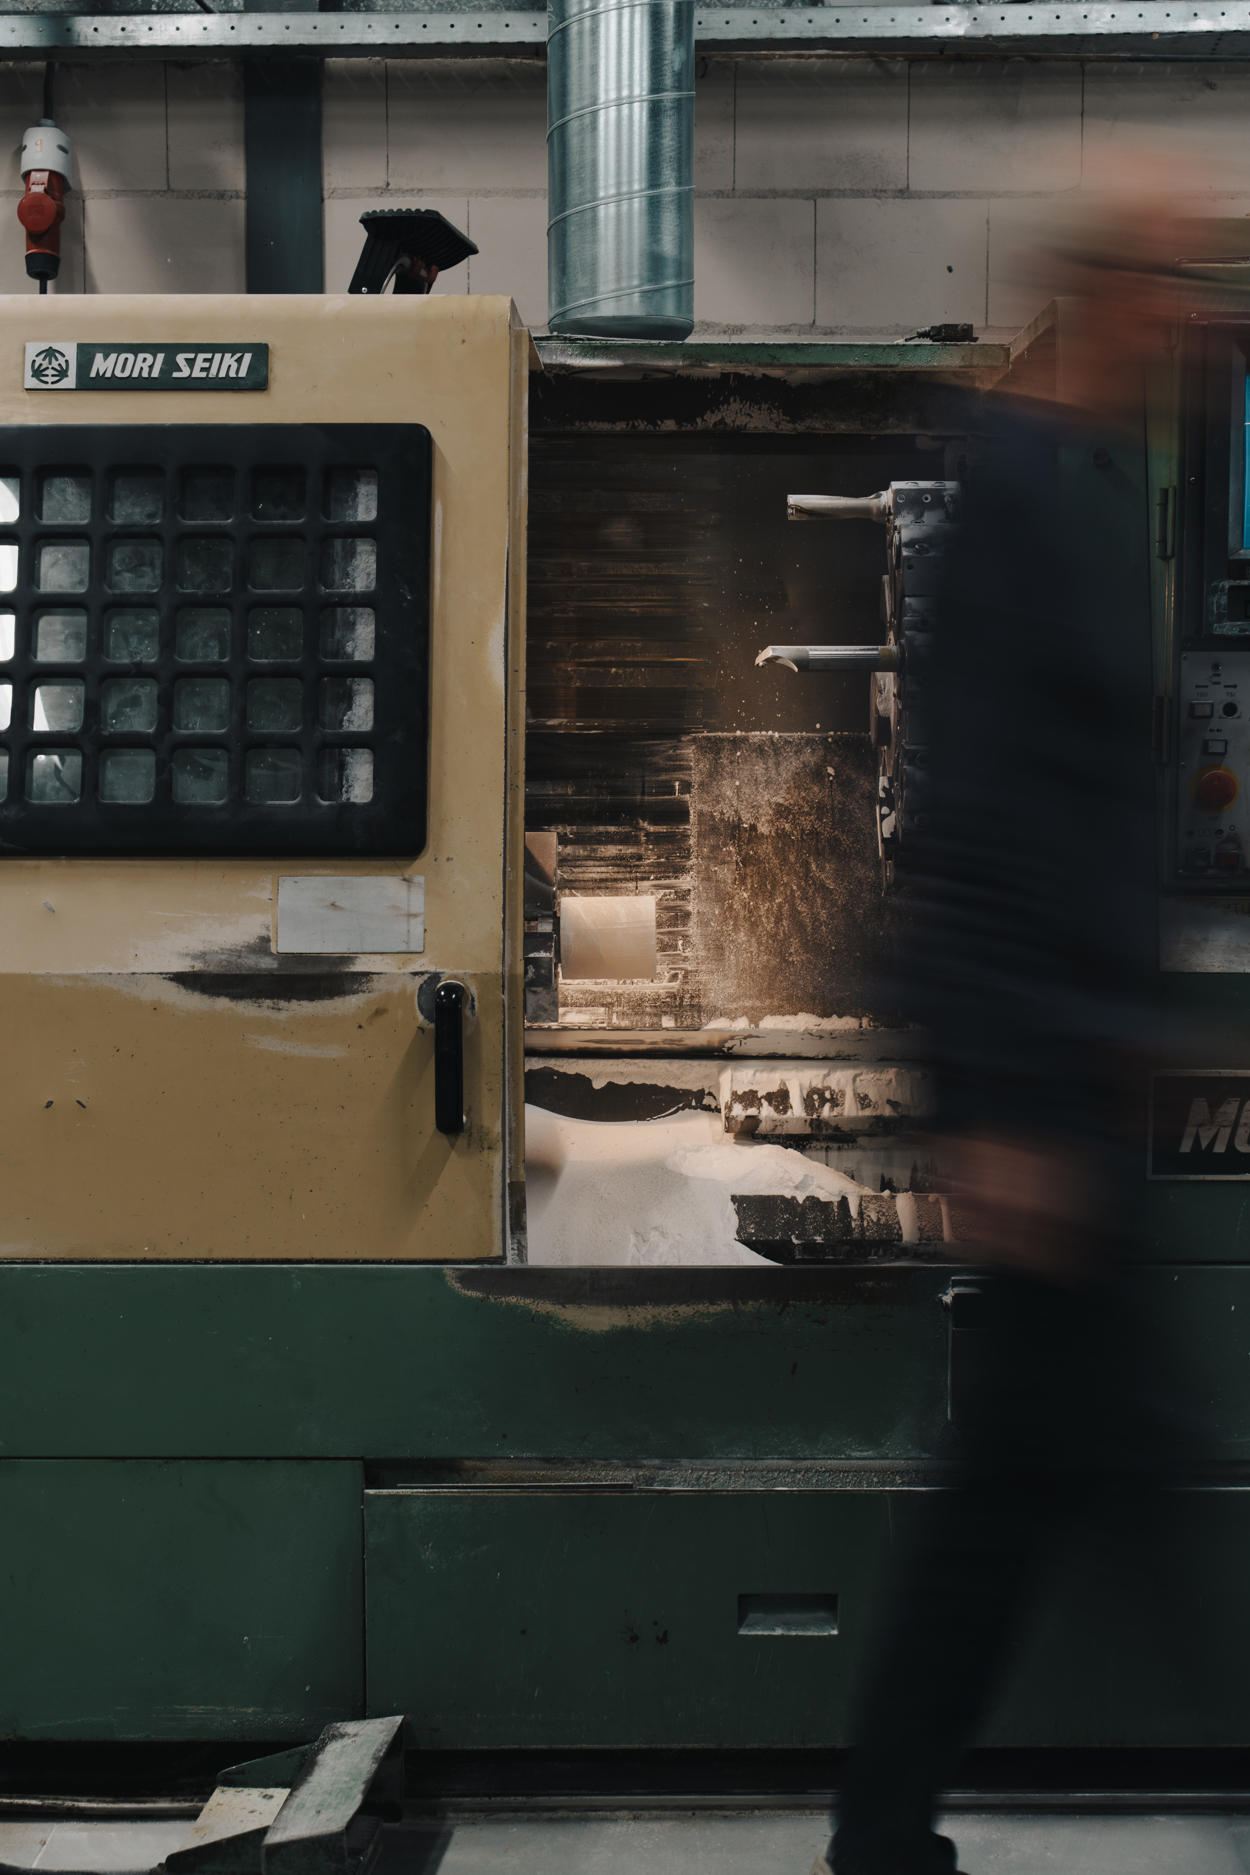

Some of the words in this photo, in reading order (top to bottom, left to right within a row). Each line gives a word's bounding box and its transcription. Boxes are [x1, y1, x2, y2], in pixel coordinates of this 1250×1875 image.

[89, 353, 165, 378] MORI
[172, 353, 253, 378] SEIKI
[1179, 1098, 1250, 1153] M
